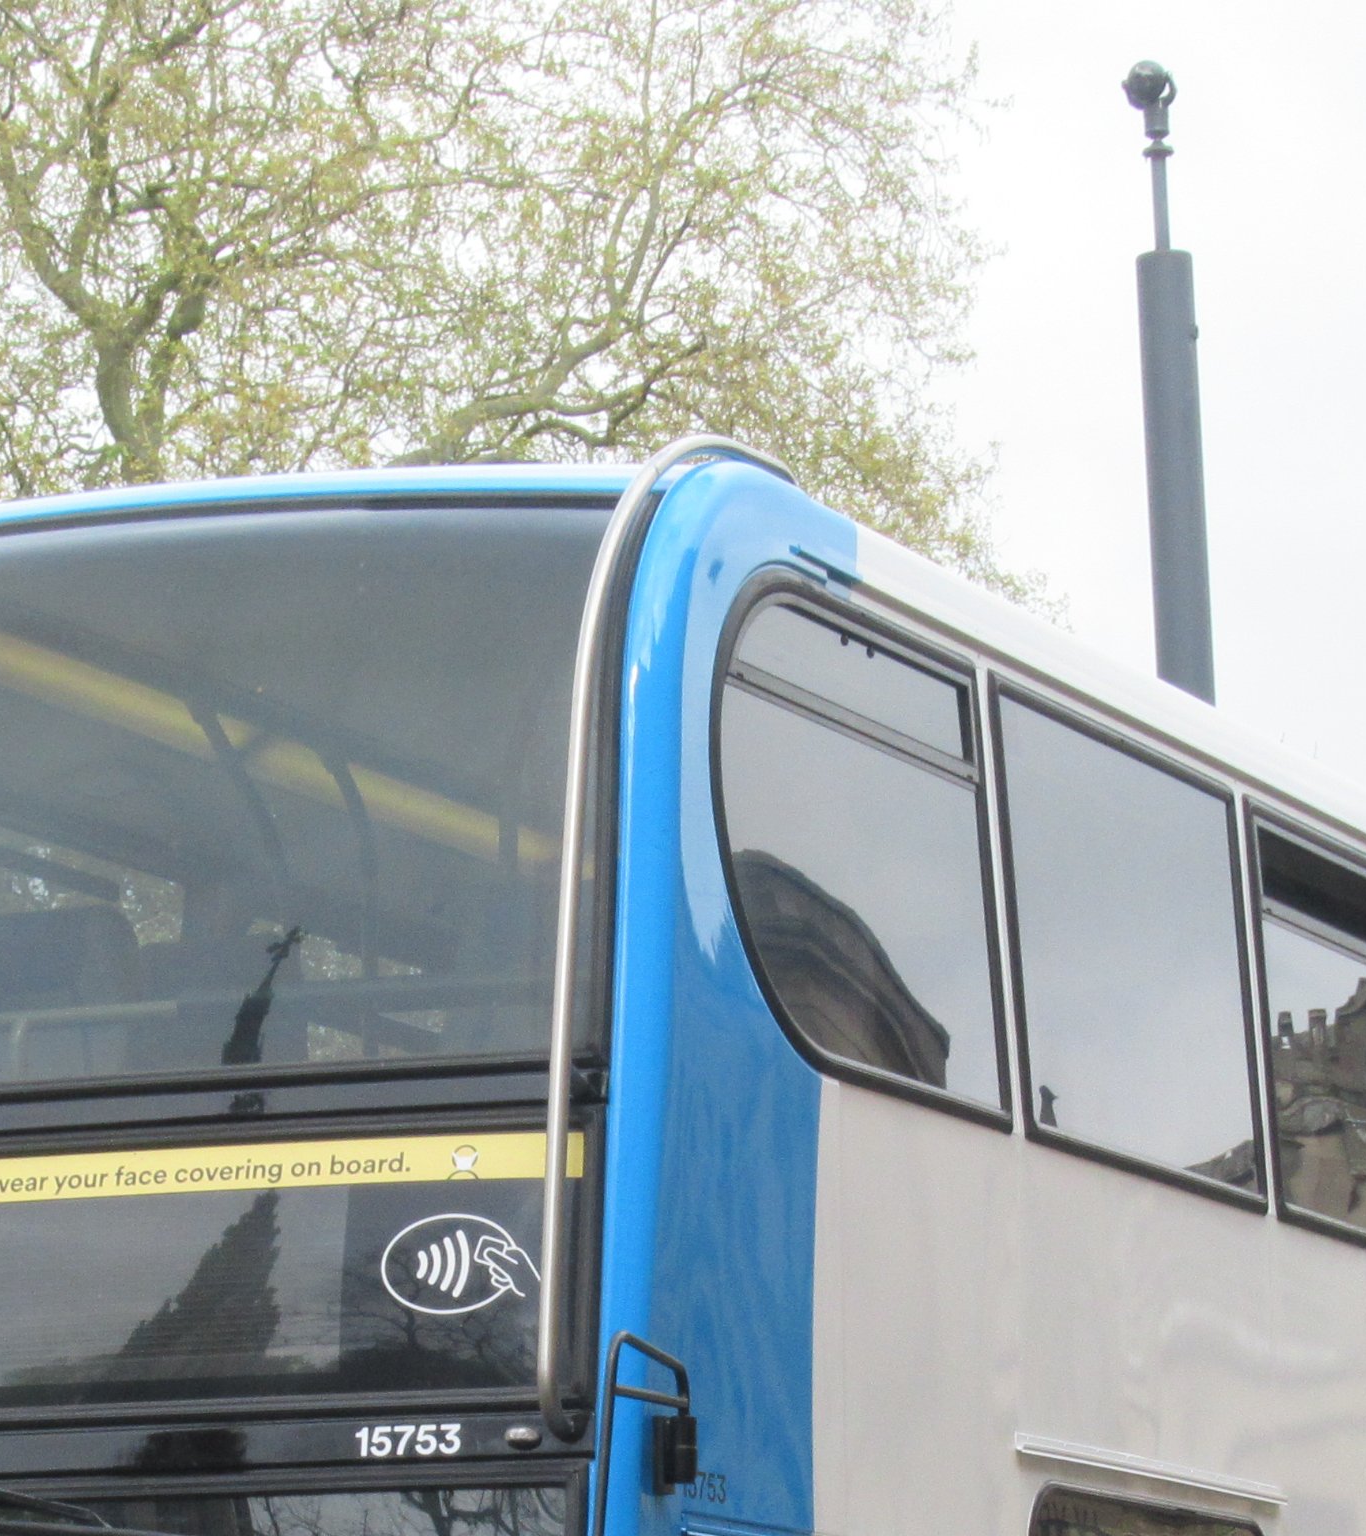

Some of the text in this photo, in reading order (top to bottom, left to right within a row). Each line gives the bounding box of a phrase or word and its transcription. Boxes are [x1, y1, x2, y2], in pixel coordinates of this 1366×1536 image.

[54, 1171, 108, 1195] your
[114, 1165, 167, 1187] face
[174, 1157, 283, 1184] covering
[290, 1160, 322, 1178] on
[329, 1152, 412, 1176] board.
[354, 1423, 462, 1457] 15753
